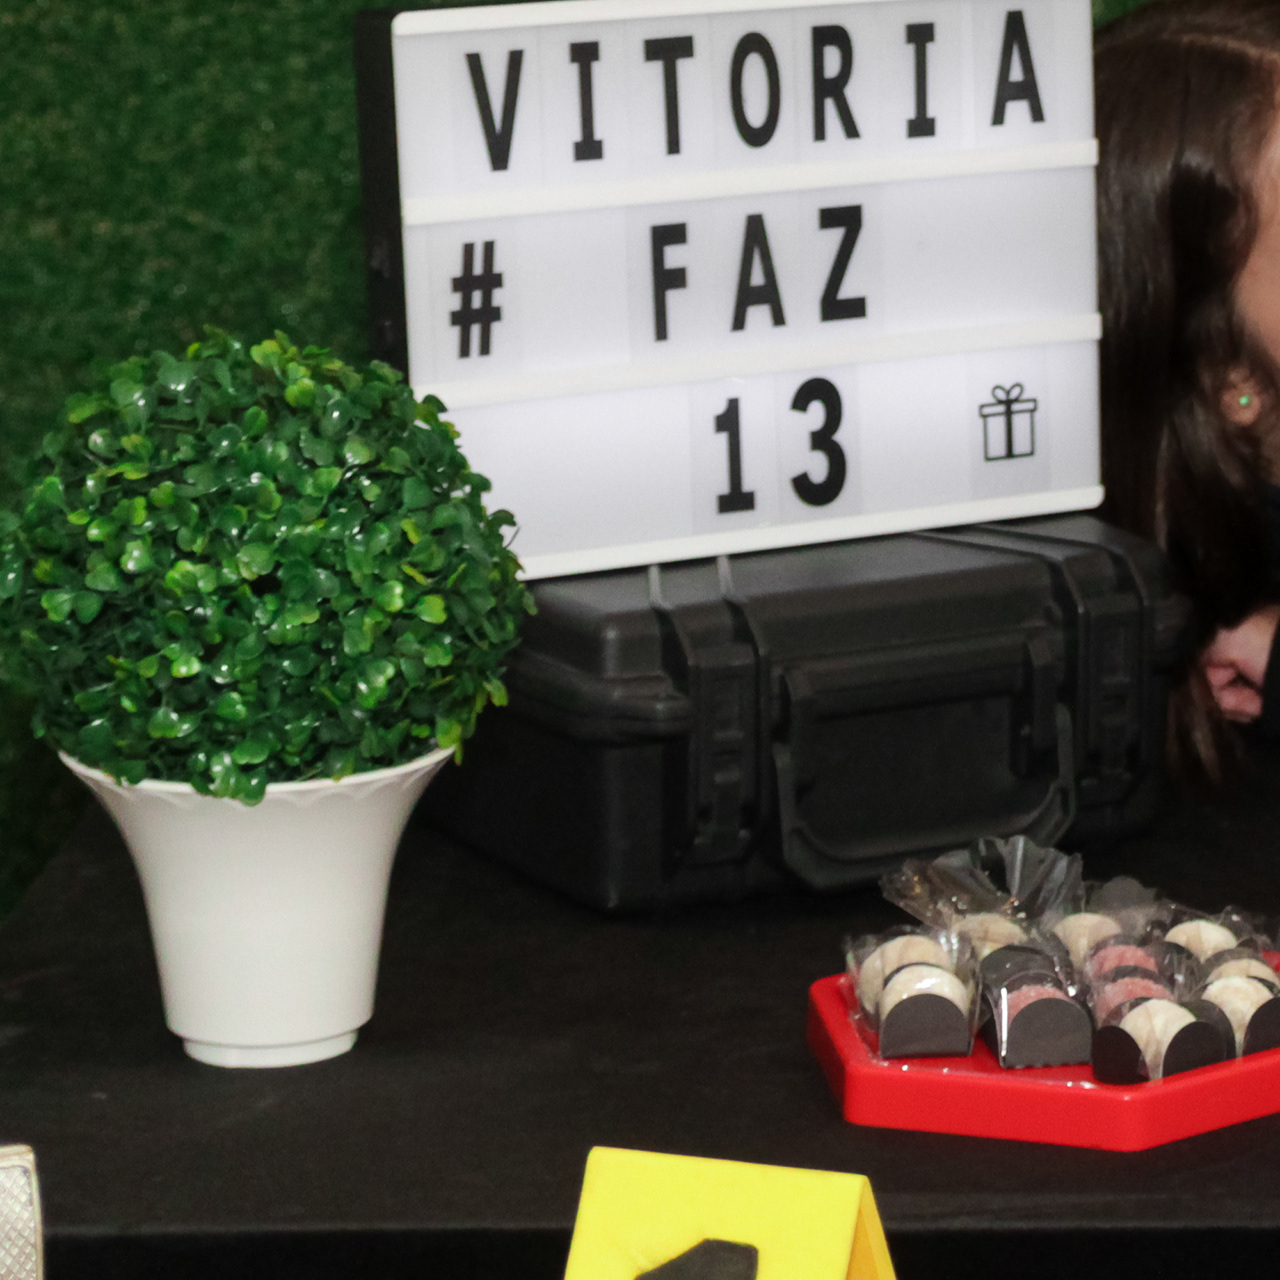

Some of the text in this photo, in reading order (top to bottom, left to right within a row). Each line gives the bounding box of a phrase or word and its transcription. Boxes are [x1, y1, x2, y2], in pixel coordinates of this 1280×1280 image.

[465, 9, 1045, 172] VITORIA
[651, 204, 867, 342] FAZ
[714, 376, 847, 514] 13
